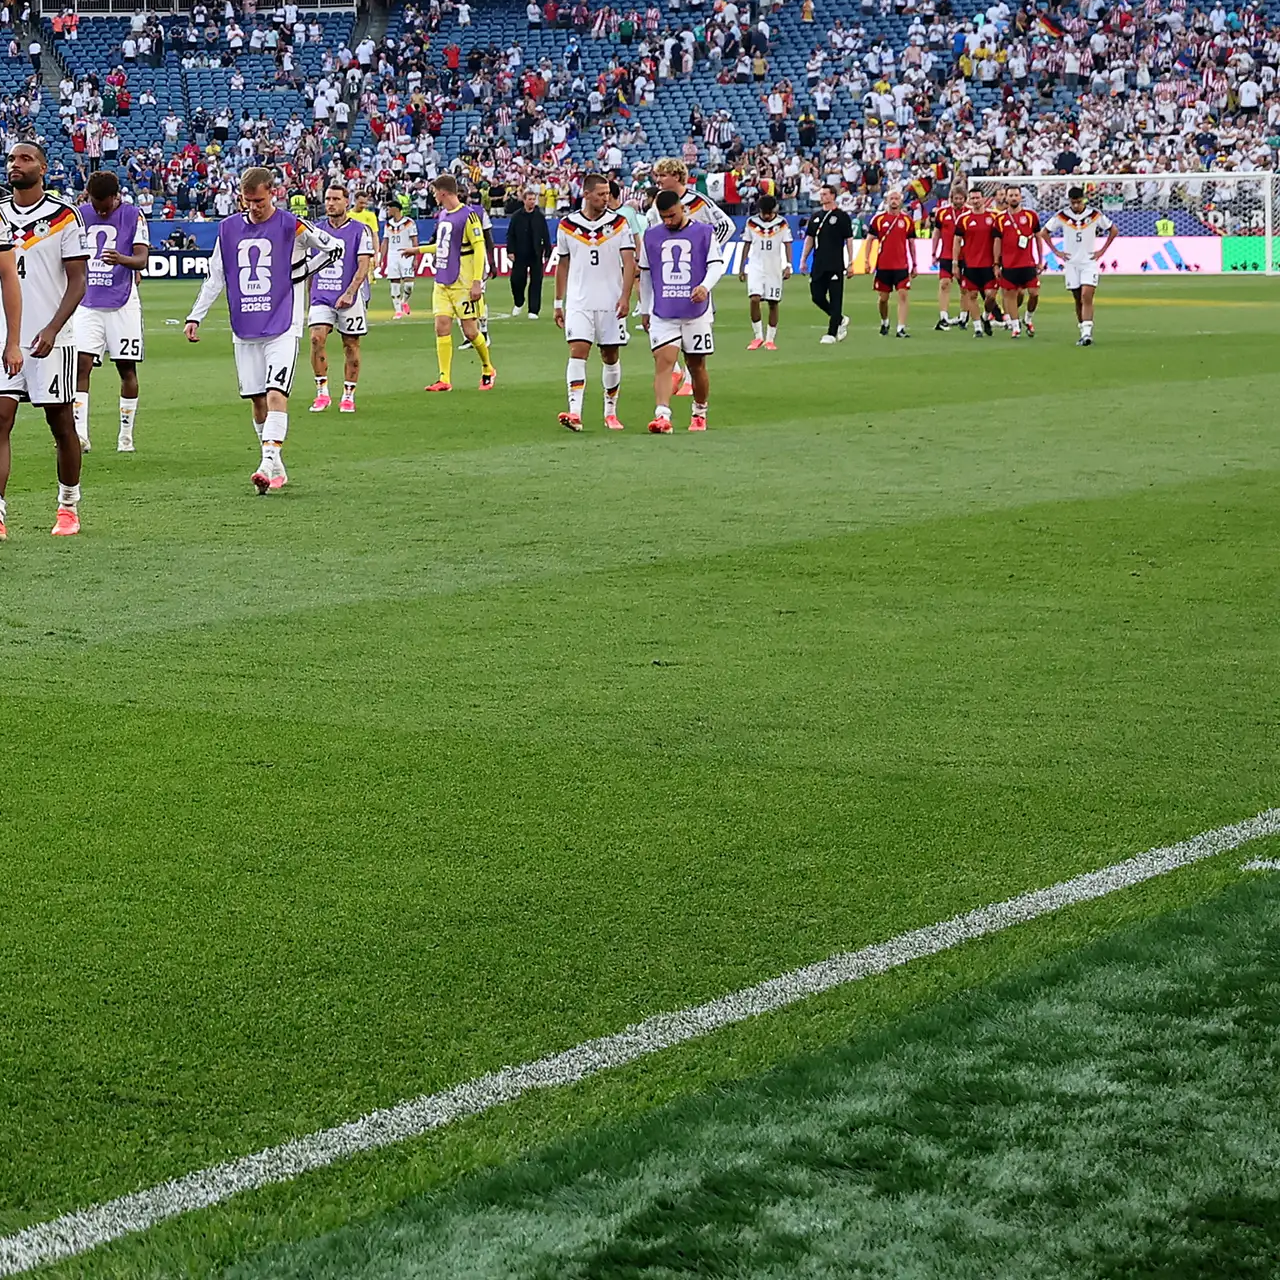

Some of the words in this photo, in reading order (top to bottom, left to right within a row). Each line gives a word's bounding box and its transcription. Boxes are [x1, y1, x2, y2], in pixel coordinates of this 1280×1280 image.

[391, 235, 401, 243] 20
[1075, 232, 1083, 243] 5
[761, 240, 772, 251] 18
[590, 250, 599, 265] 3
[17, 255, 27, 279] 4
[140, 255, 177, 277] DI
[317, 283, 342, 291] 2026
[662, 290, 691, 298] 2026
[770, 287, 780, 298] 18
[241, 302, 271, 313] 2026
[346, 316, 364, 332] 22
[618, 324, 626, 341] 3
[120, 338, 139, 357] 25
[692, 334, 712, 351] 26
[266, 365, 288, 386] 14
[48, 374, 60, 399] 4
